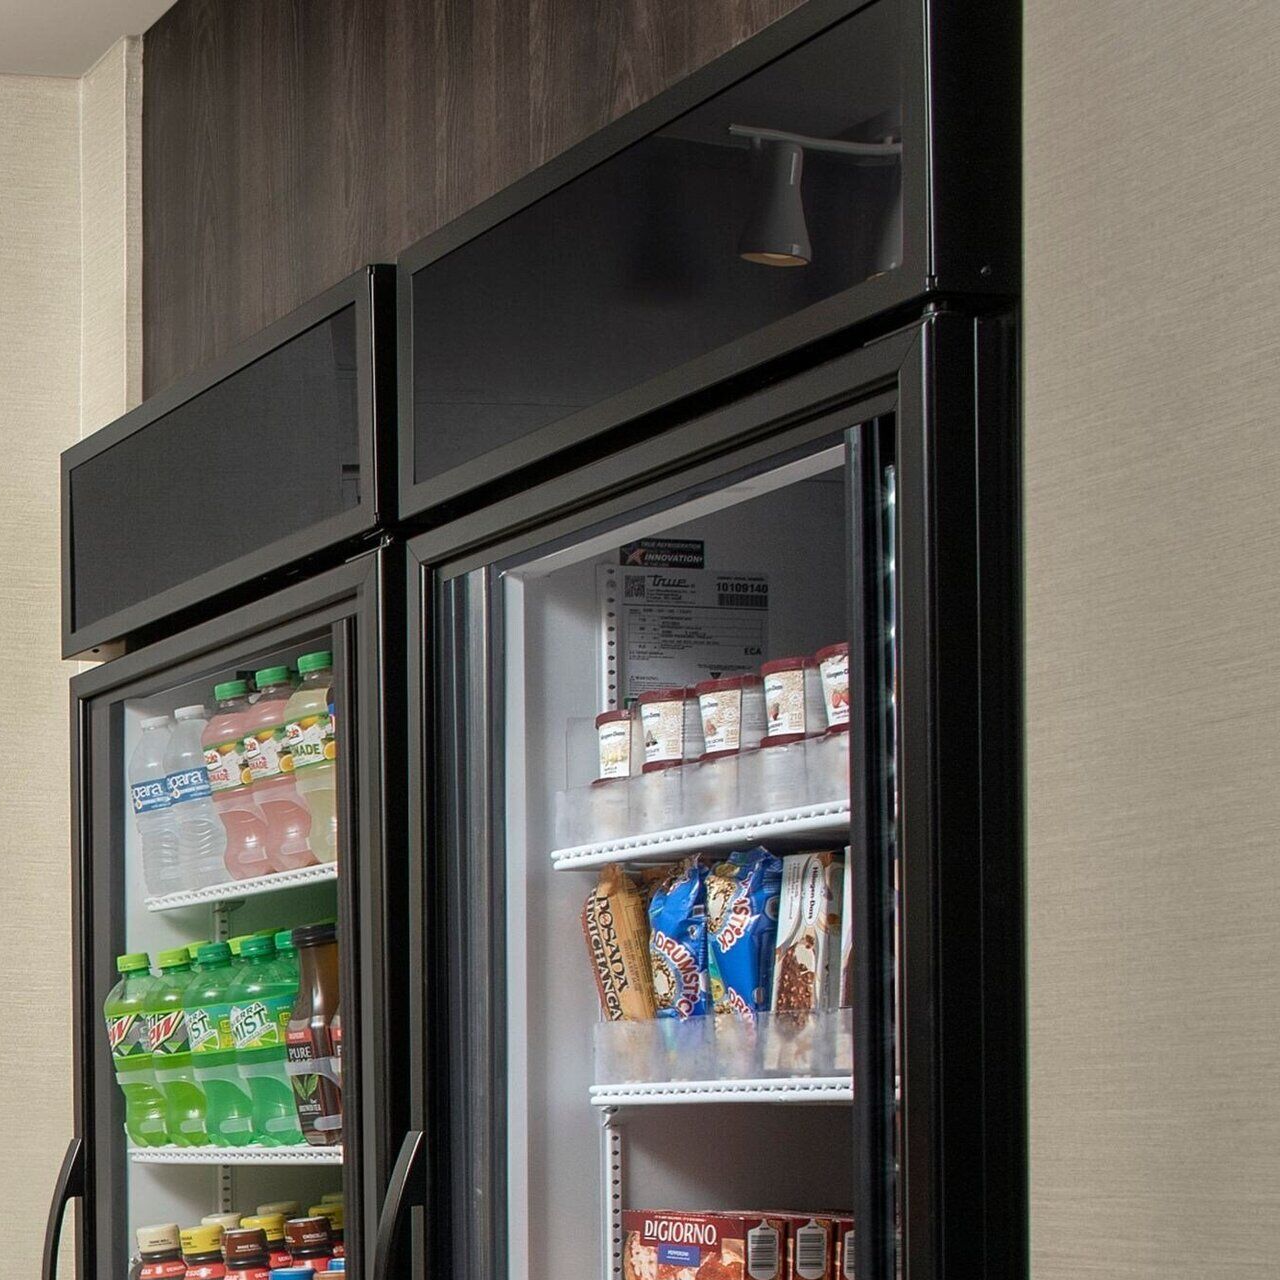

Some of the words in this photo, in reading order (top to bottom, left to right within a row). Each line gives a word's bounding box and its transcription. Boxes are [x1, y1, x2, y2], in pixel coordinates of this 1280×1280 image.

[597, 896, 628, 992] POSADA
[655, 931, 700, 1021] DRUMSTICK
[289, 1045, 311, 1058] PURE
[644, 1220, 717, 1246] DIGIORNO
